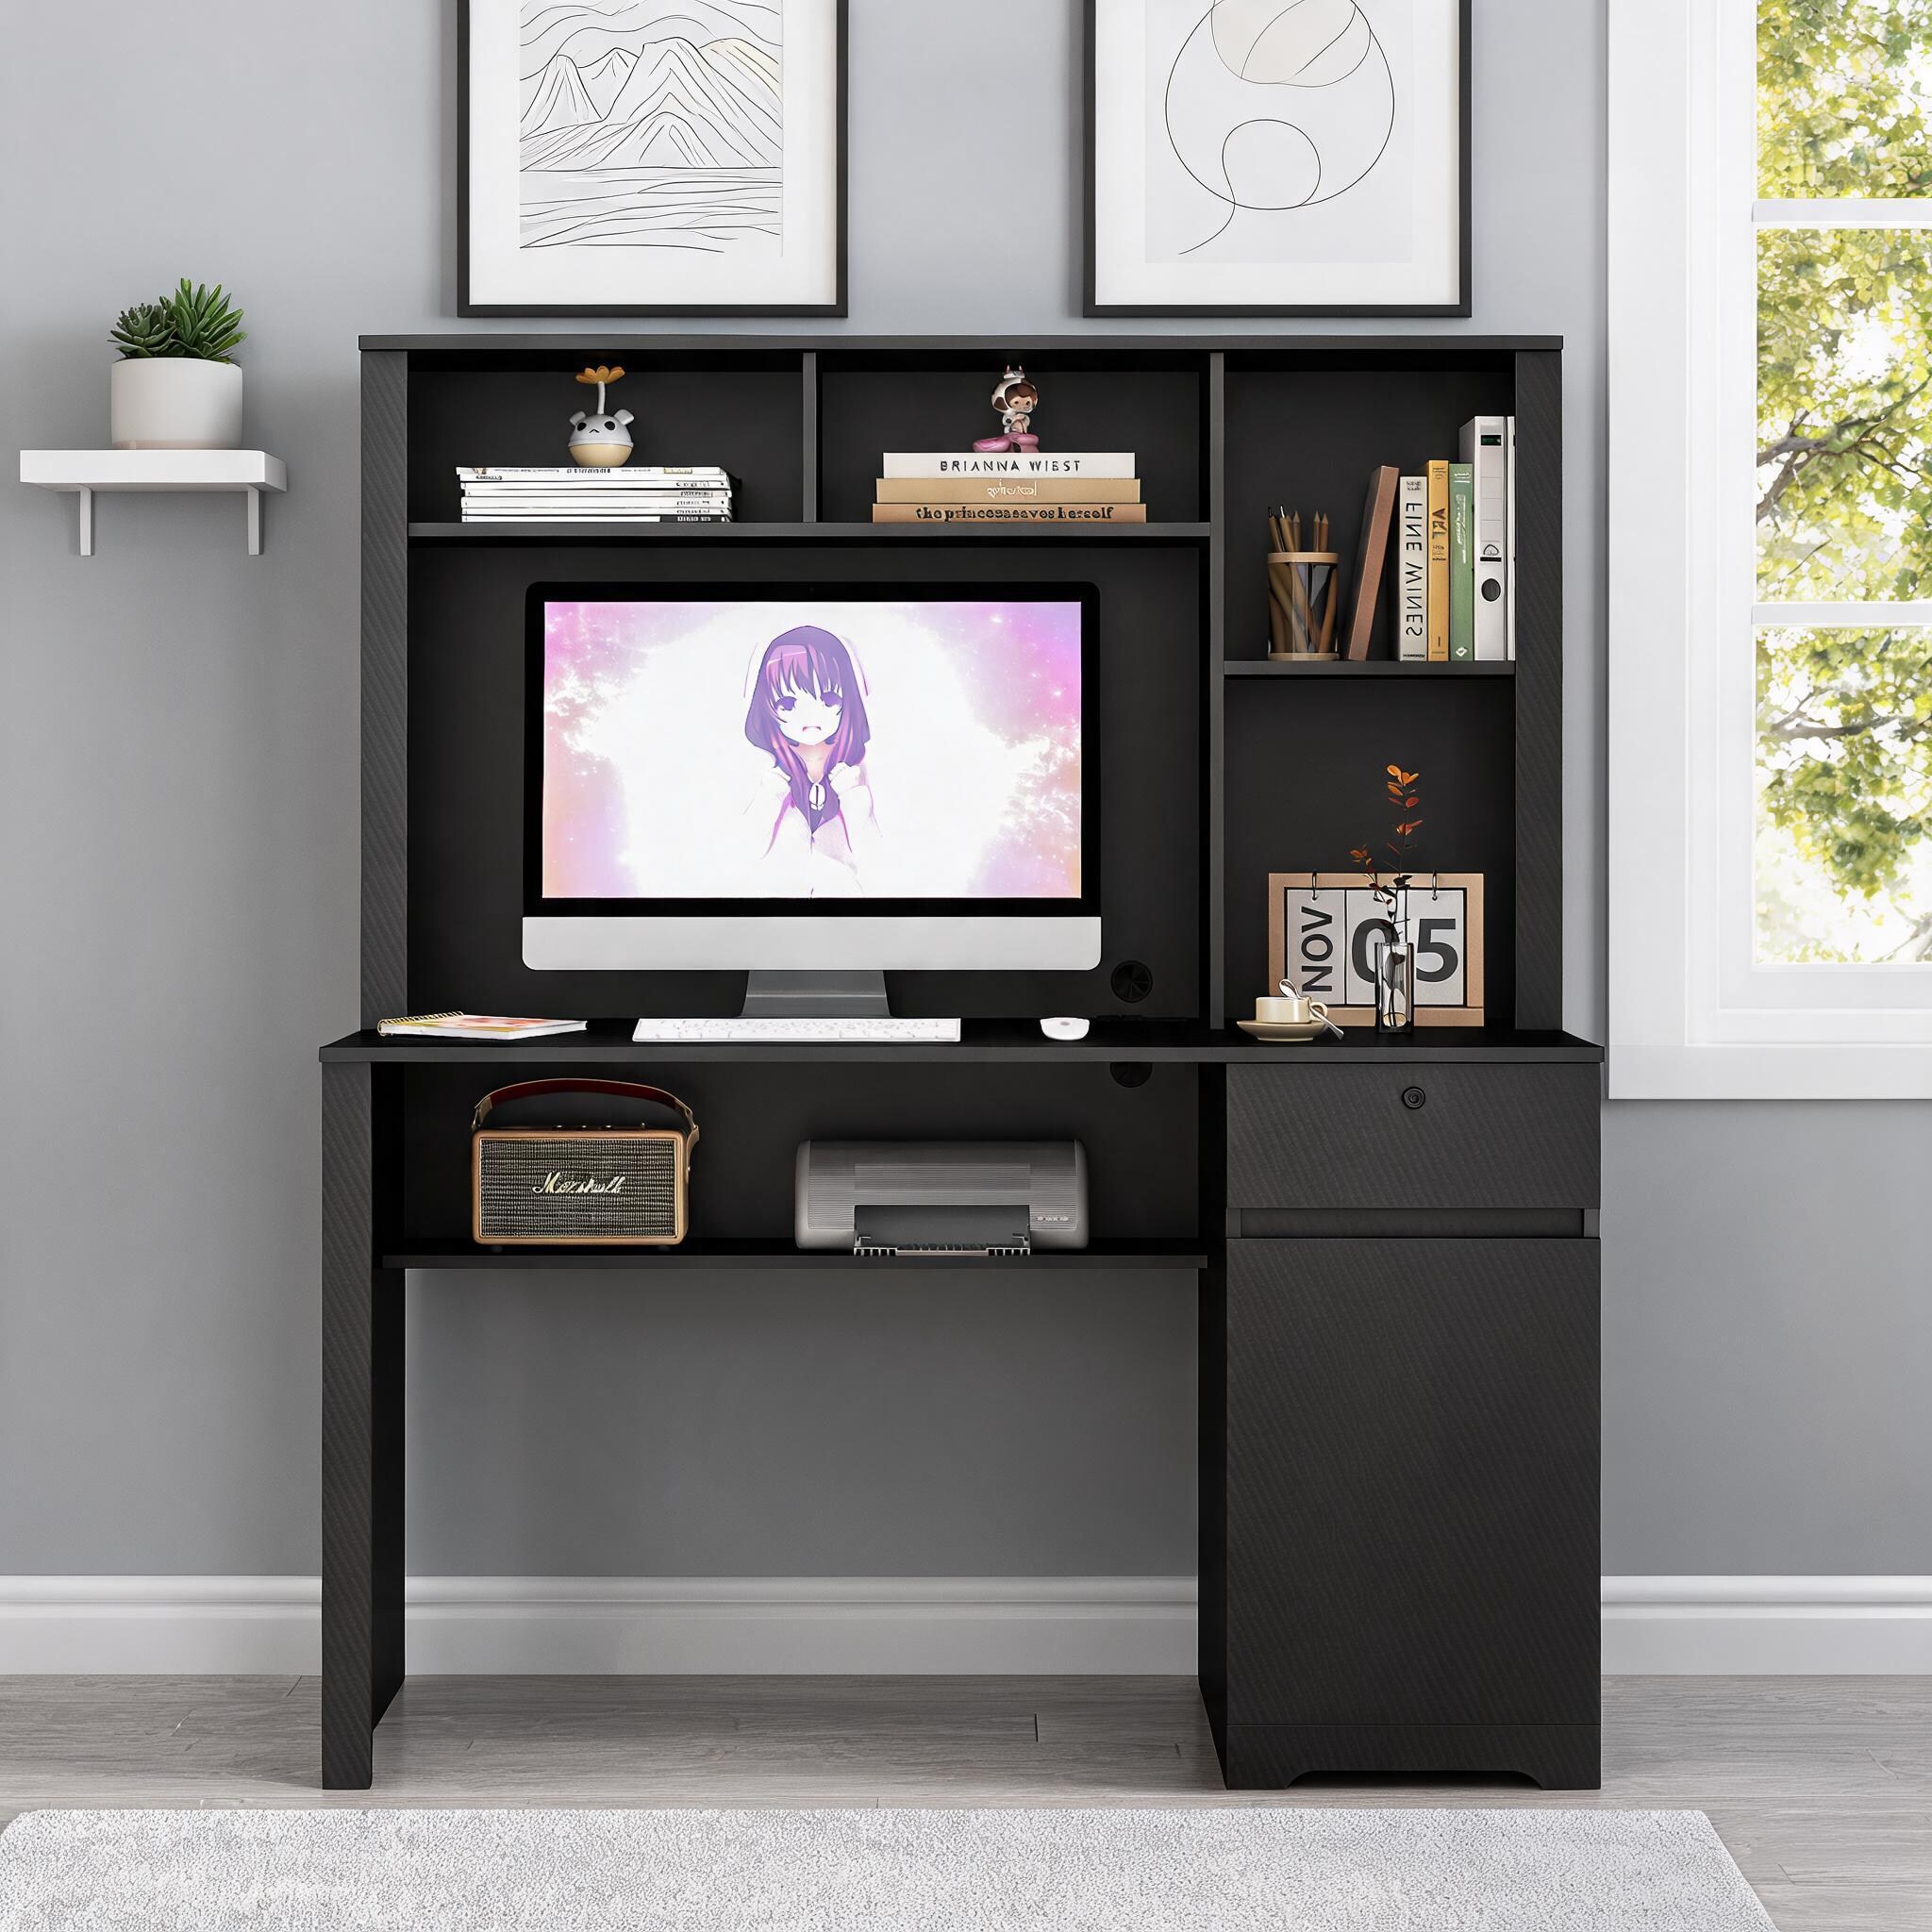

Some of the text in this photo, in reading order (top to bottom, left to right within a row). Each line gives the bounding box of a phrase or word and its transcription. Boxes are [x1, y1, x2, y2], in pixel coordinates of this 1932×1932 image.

[940, 460, 1080, 472] BRIANNA WIEST
[1301, 906, 1333, 992] NOV
